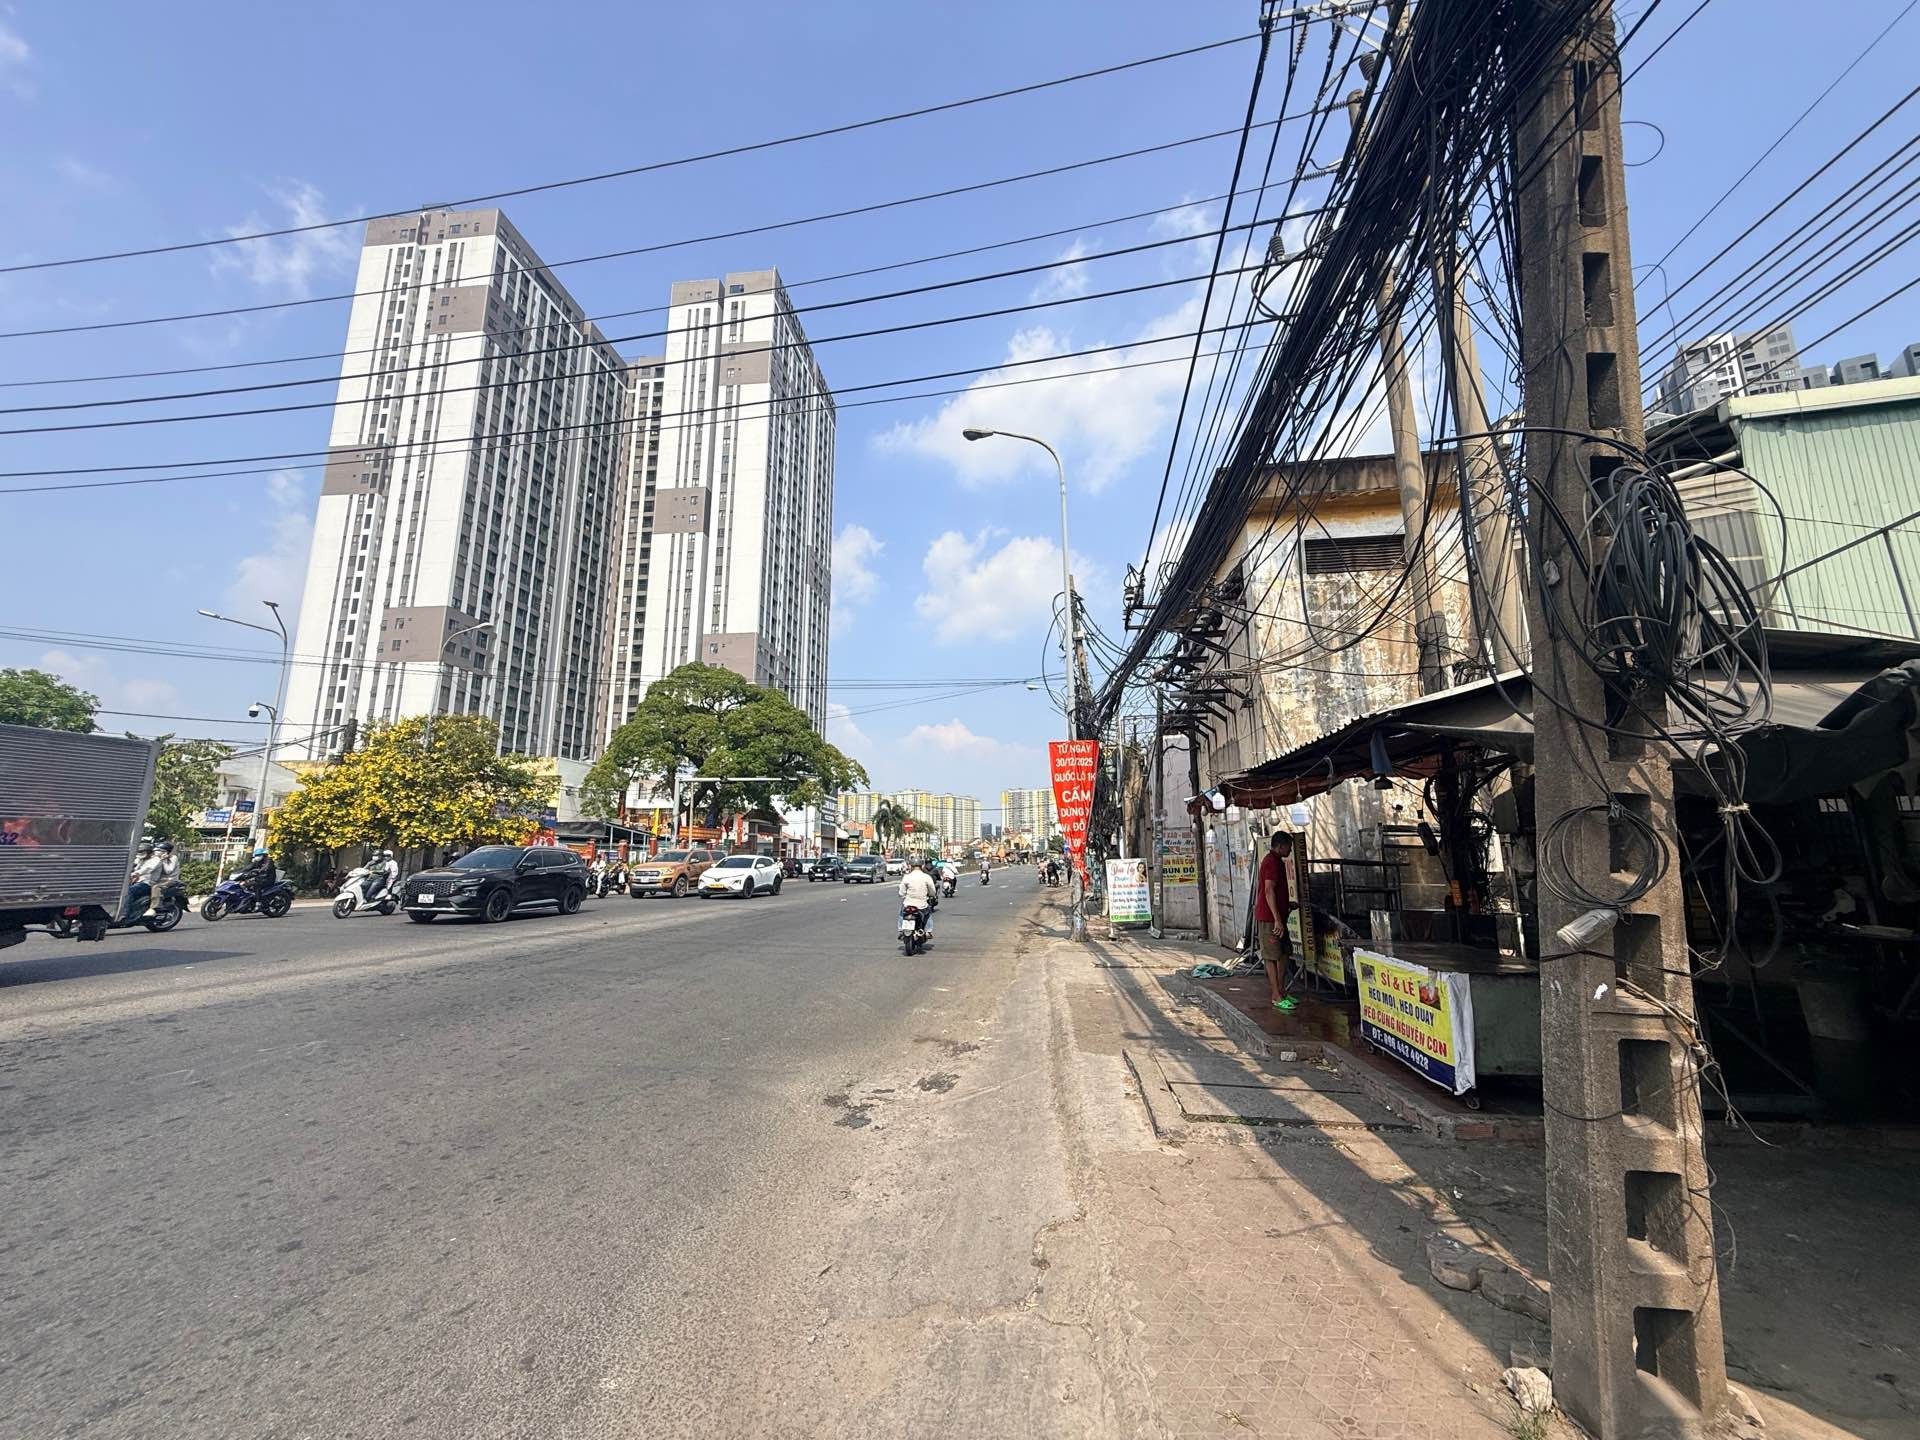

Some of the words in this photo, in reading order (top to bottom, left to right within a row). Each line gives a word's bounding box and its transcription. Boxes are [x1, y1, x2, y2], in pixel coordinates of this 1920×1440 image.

[1055, 757, 1094, 767] 30/12/2025
[1061, 786, 1091, 803] CẤM
[1392, 977, 1400, 991] &
[1368, 986, 1381, 1002] HEO
[1399, 998, 1414, 1016] HEO
[1415, 1006, 1435, 1026] QUAY
[1363, 1005, 1376, 1020] HEO
[1396, 1017, 1426, 1047] NGUYÊN
[1427, 1036, 1447, 1057] CON
